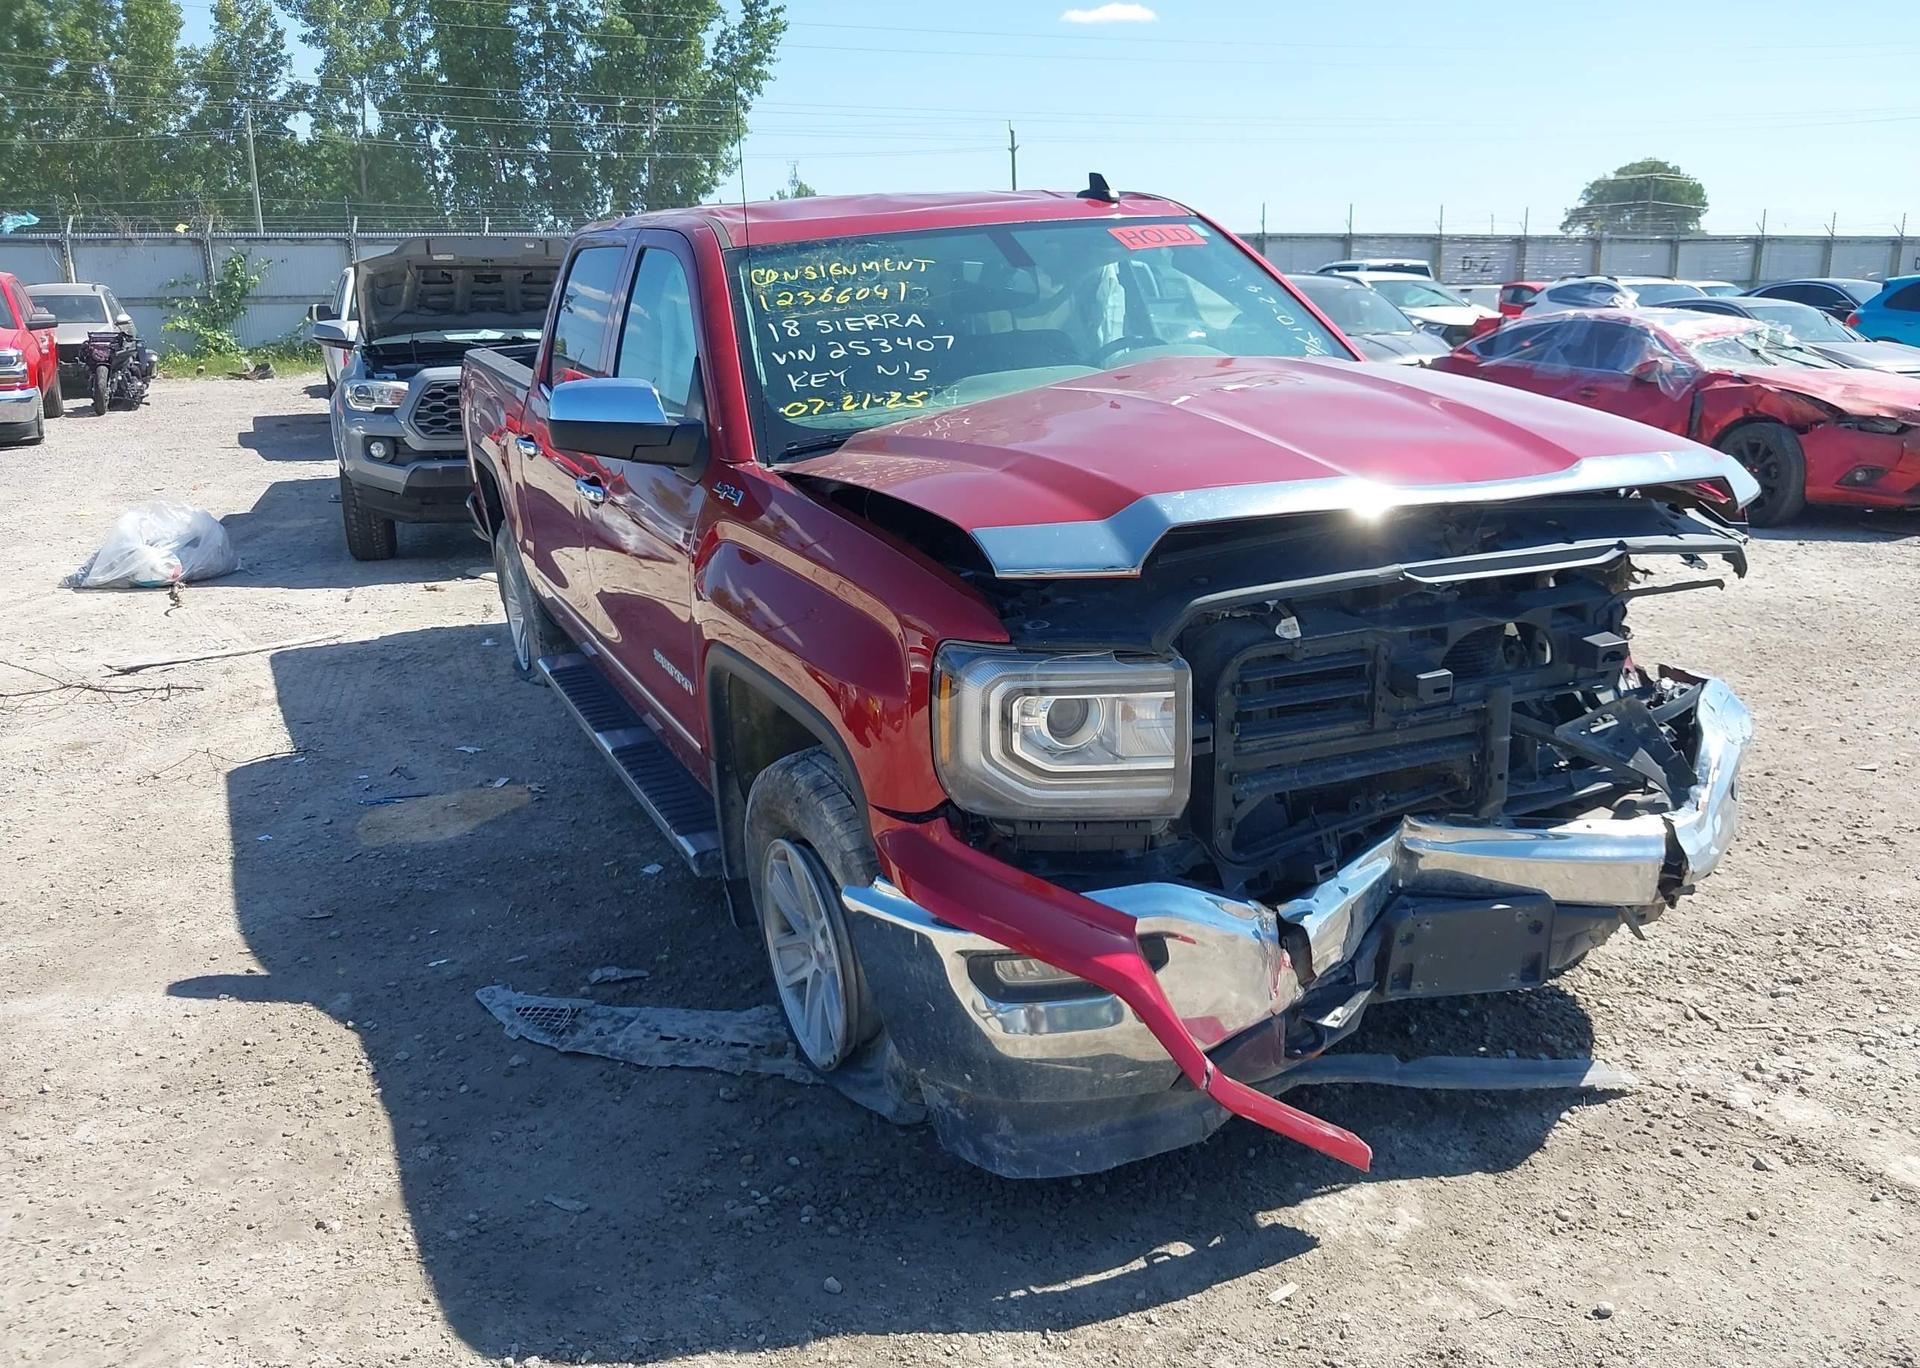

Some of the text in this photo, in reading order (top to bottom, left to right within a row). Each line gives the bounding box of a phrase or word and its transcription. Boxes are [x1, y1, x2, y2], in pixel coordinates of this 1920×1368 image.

[1118, 228, 1195, 246] HOLD
[751, 258, 936, 286] CONSIGNMENT
[768, 313, 926, 342] 18 SIERRA
[772, 335, 955, 366] VIN 253407
[787, 366, 852, 392] KEY
